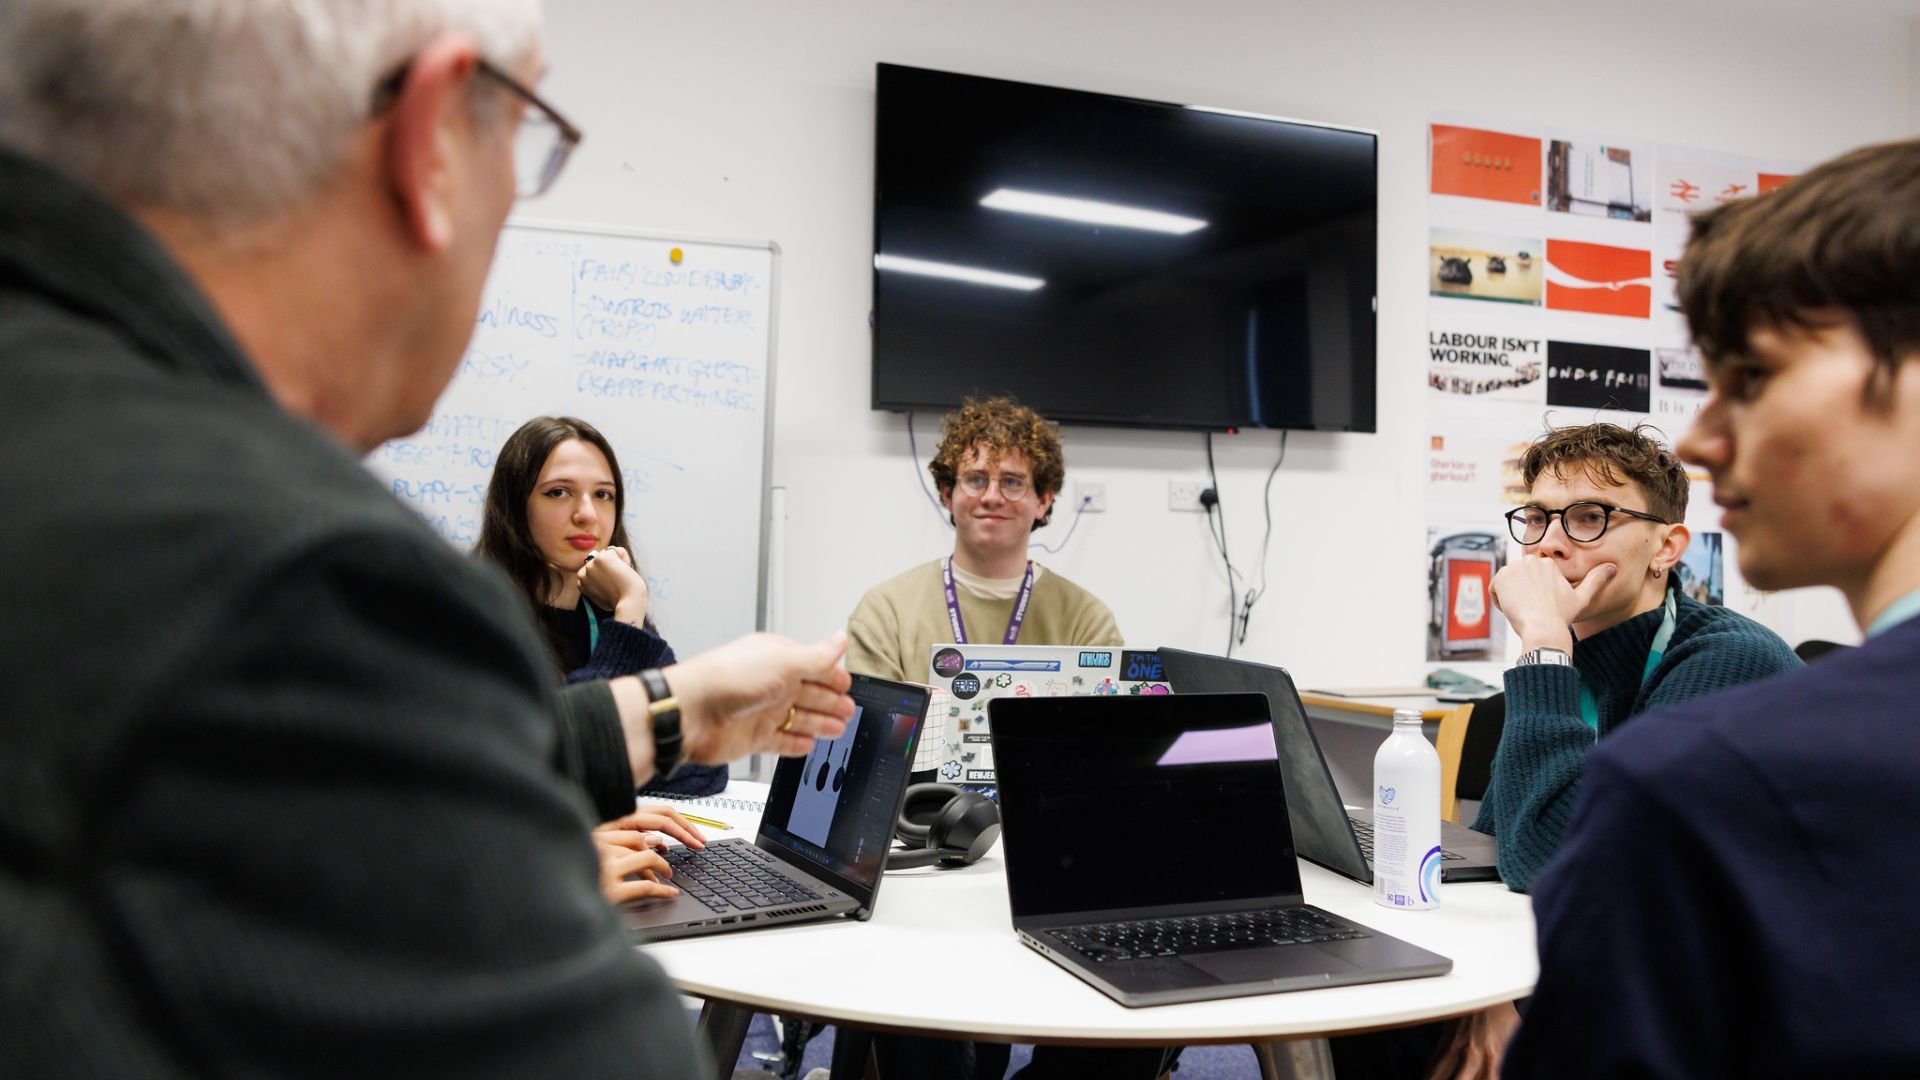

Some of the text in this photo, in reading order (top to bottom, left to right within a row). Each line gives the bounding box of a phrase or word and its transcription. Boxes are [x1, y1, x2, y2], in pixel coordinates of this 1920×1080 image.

[1429, 331, 1540, 354] LABOUR ISN'T
[1430, 347, 1512, 367] WORKING.
[1127, 663, 1162, 679] ONE
